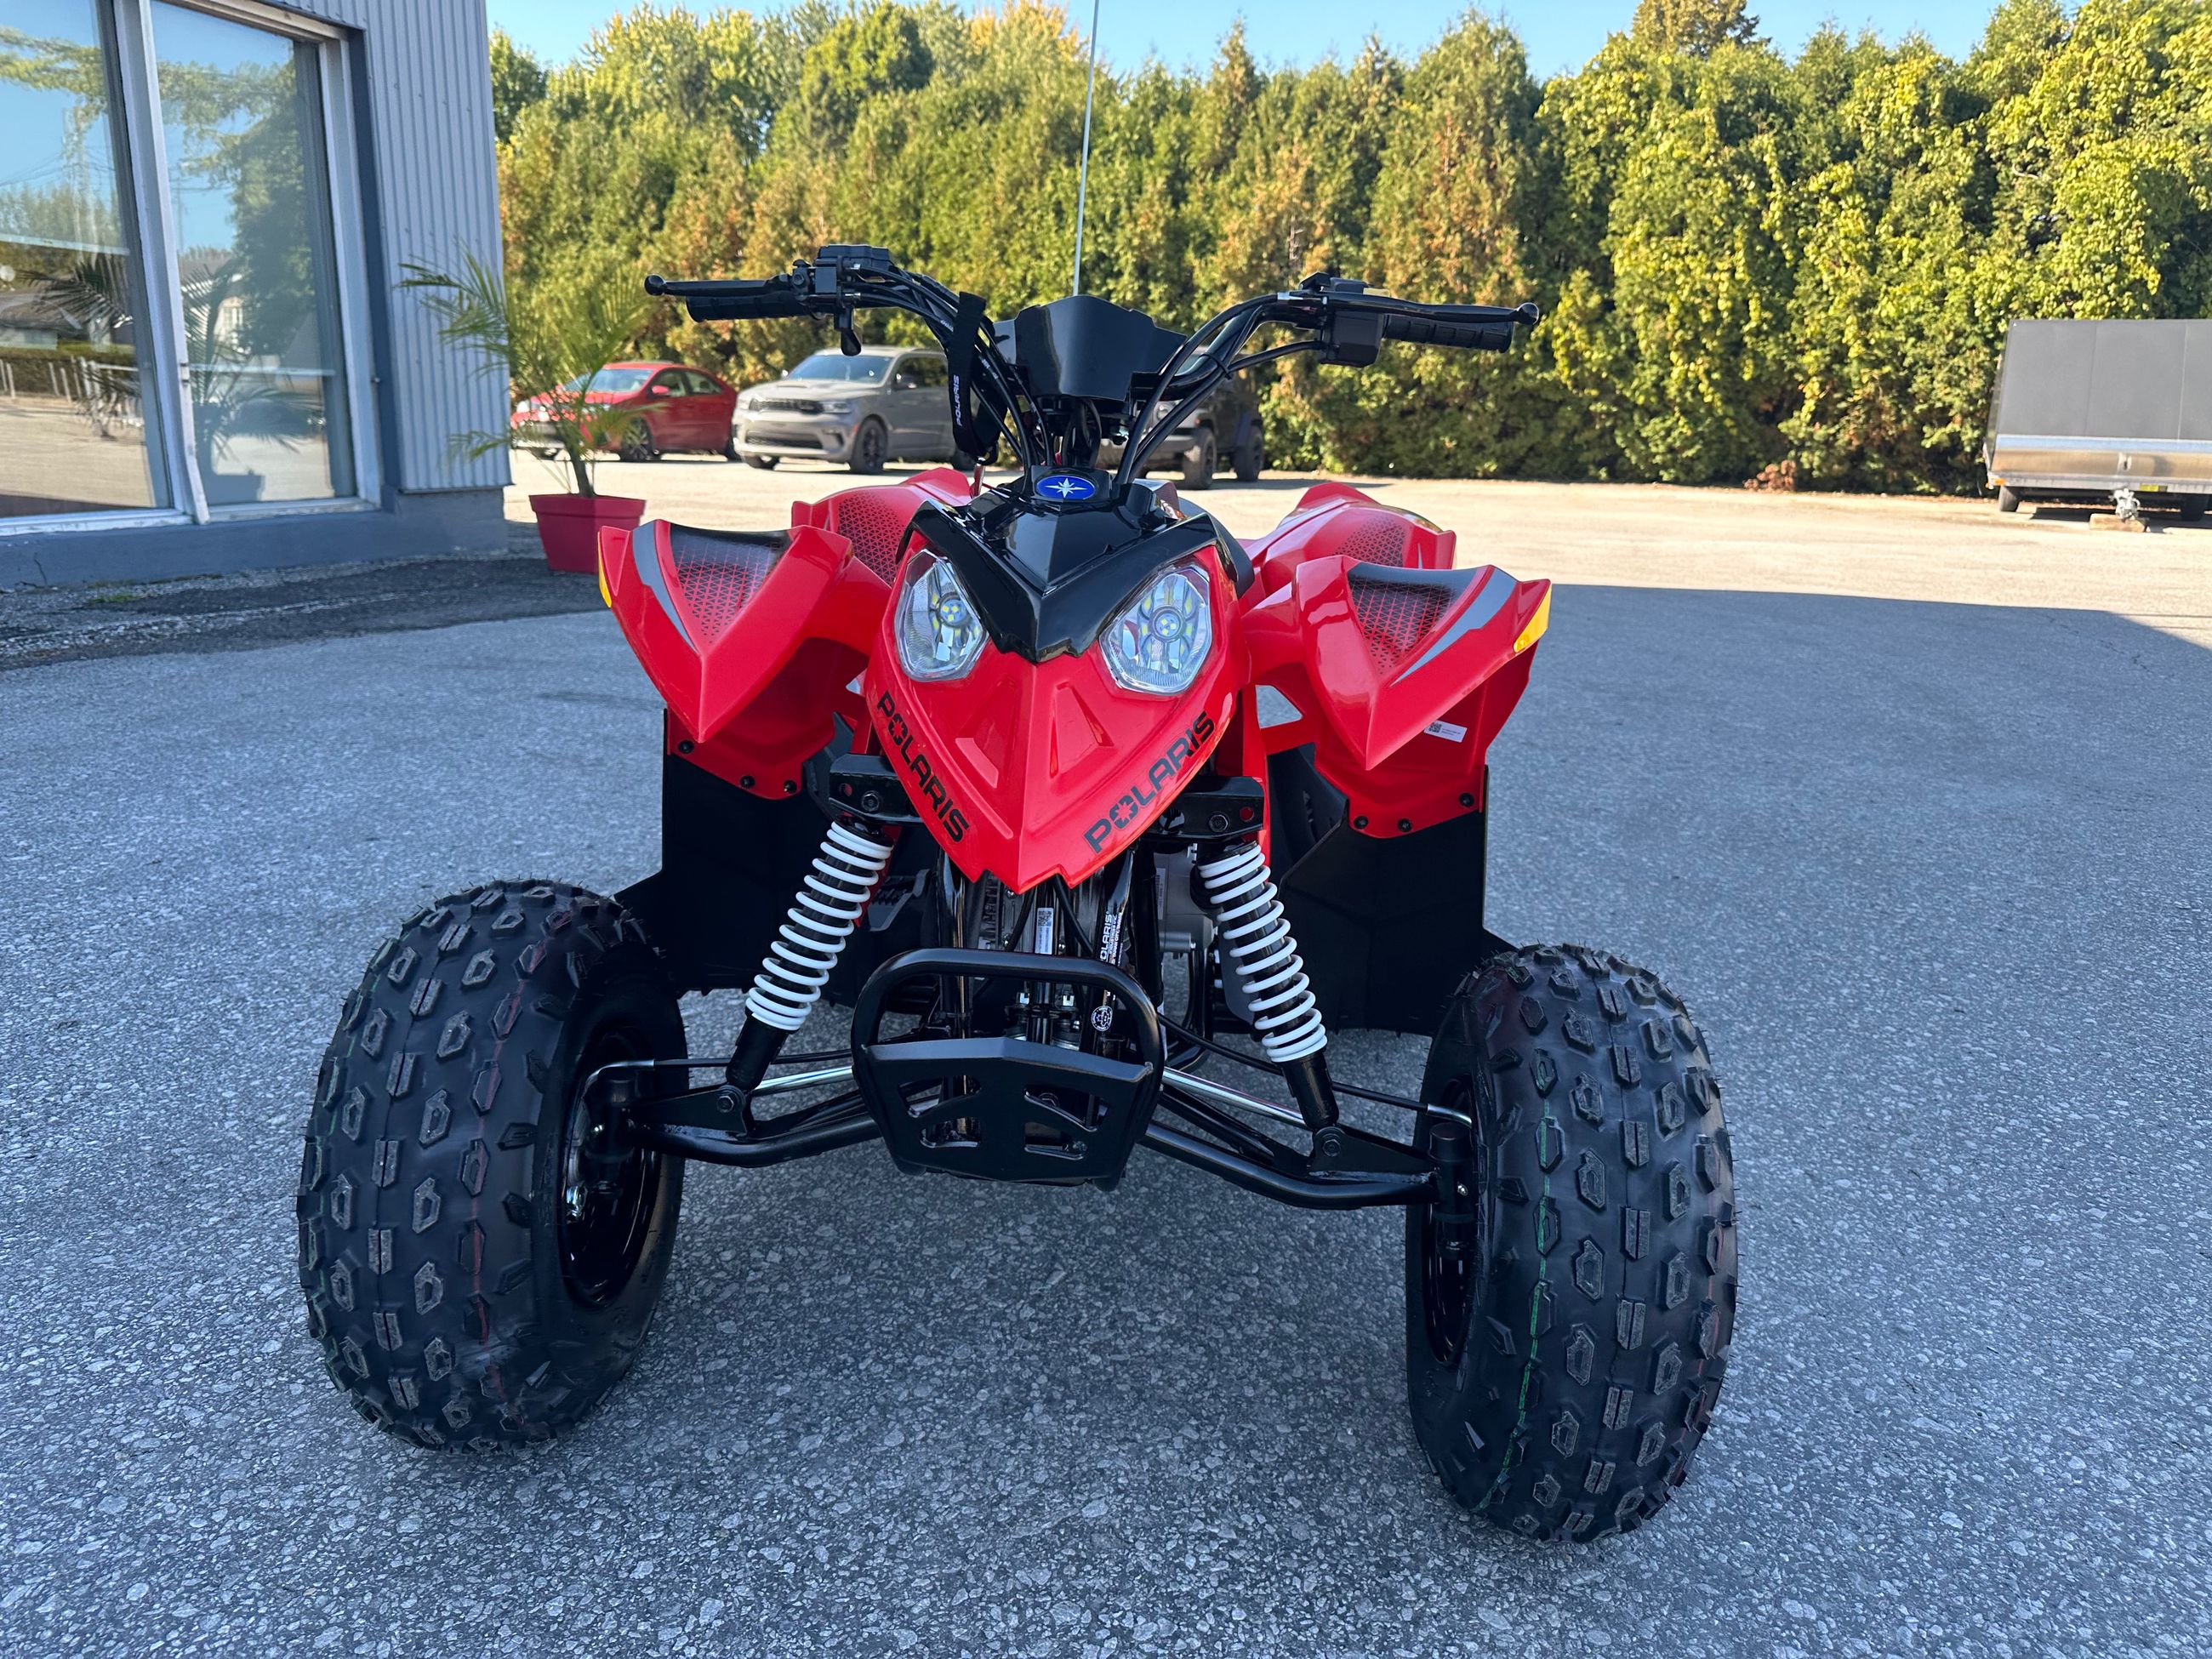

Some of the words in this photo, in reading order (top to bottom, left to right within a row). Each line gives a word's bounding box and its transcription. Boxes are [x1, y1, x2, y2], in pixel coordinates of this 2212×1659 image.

[953, 374, 962, 426] POLARIS
[877, 691, 970, 843] POLARIS
[1084, 710, 1215, 854] POLARIS
[1099, 914, 1112, 961] OLARIS
